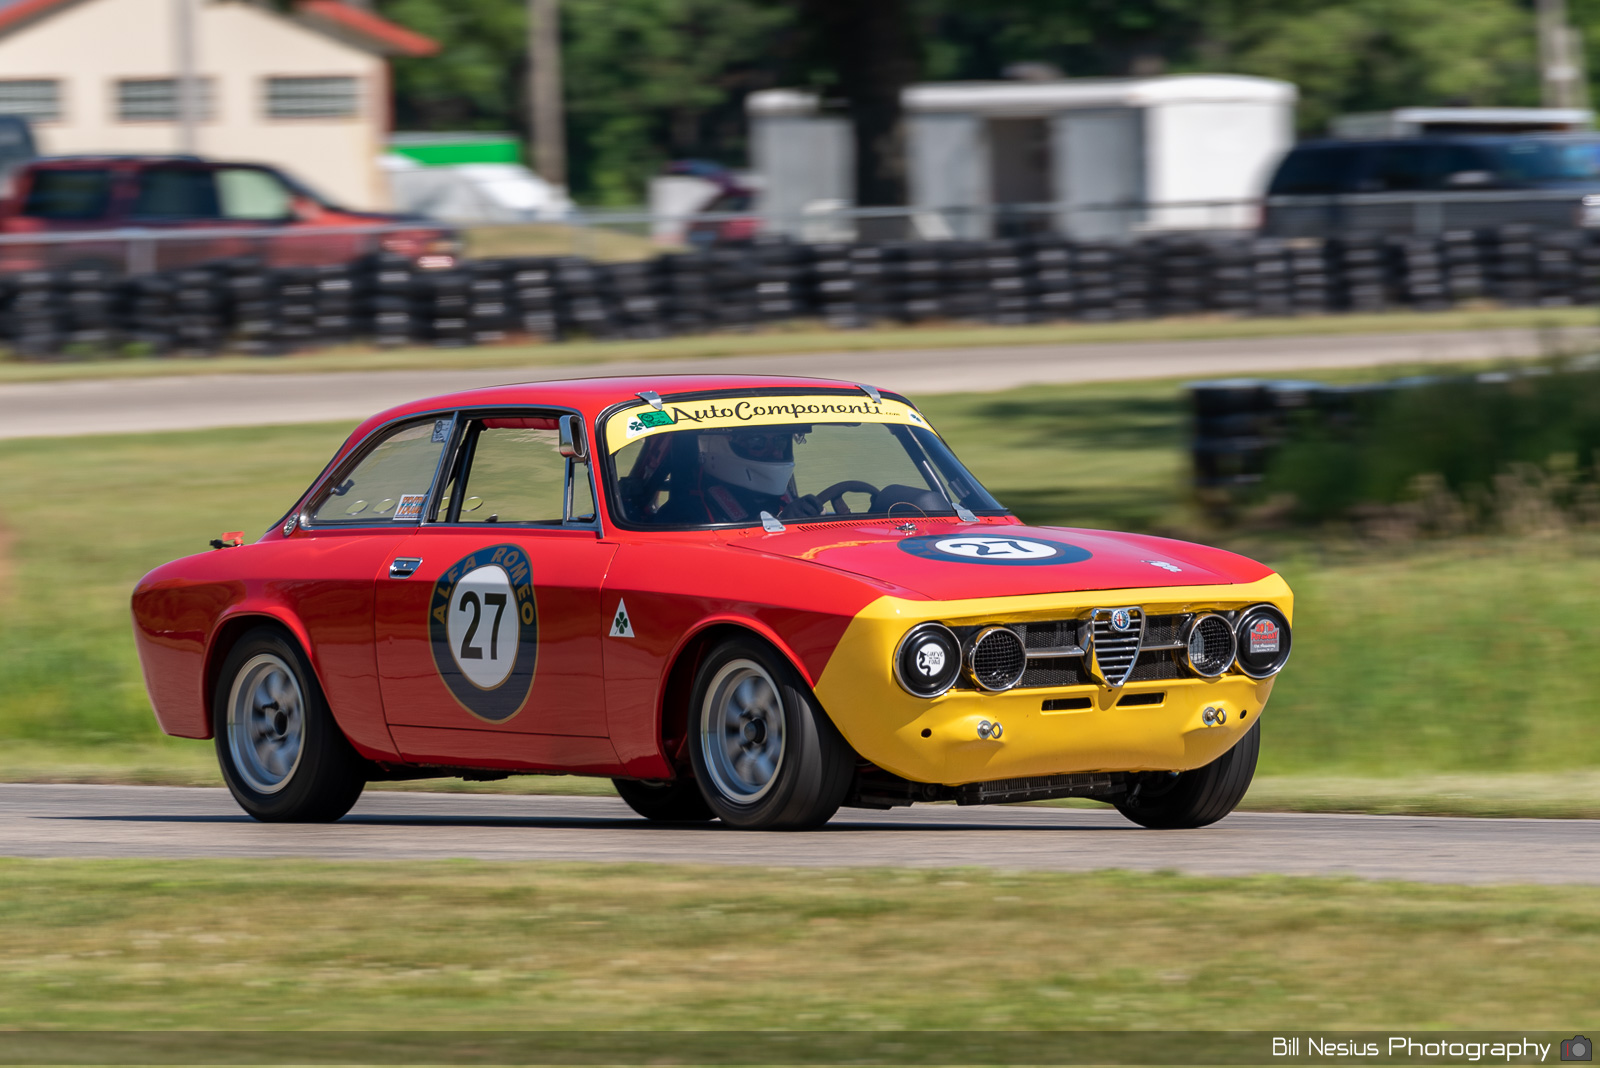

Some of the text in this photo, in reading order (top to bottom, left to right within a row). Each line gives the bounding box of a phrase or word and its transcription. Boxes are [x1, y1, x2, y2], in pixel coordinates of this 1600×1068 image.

[949, 540, 1033, 556] 27
[433, 547, 534, 625] ALFA ROMEO
[459, 591, 507, 660] 27
